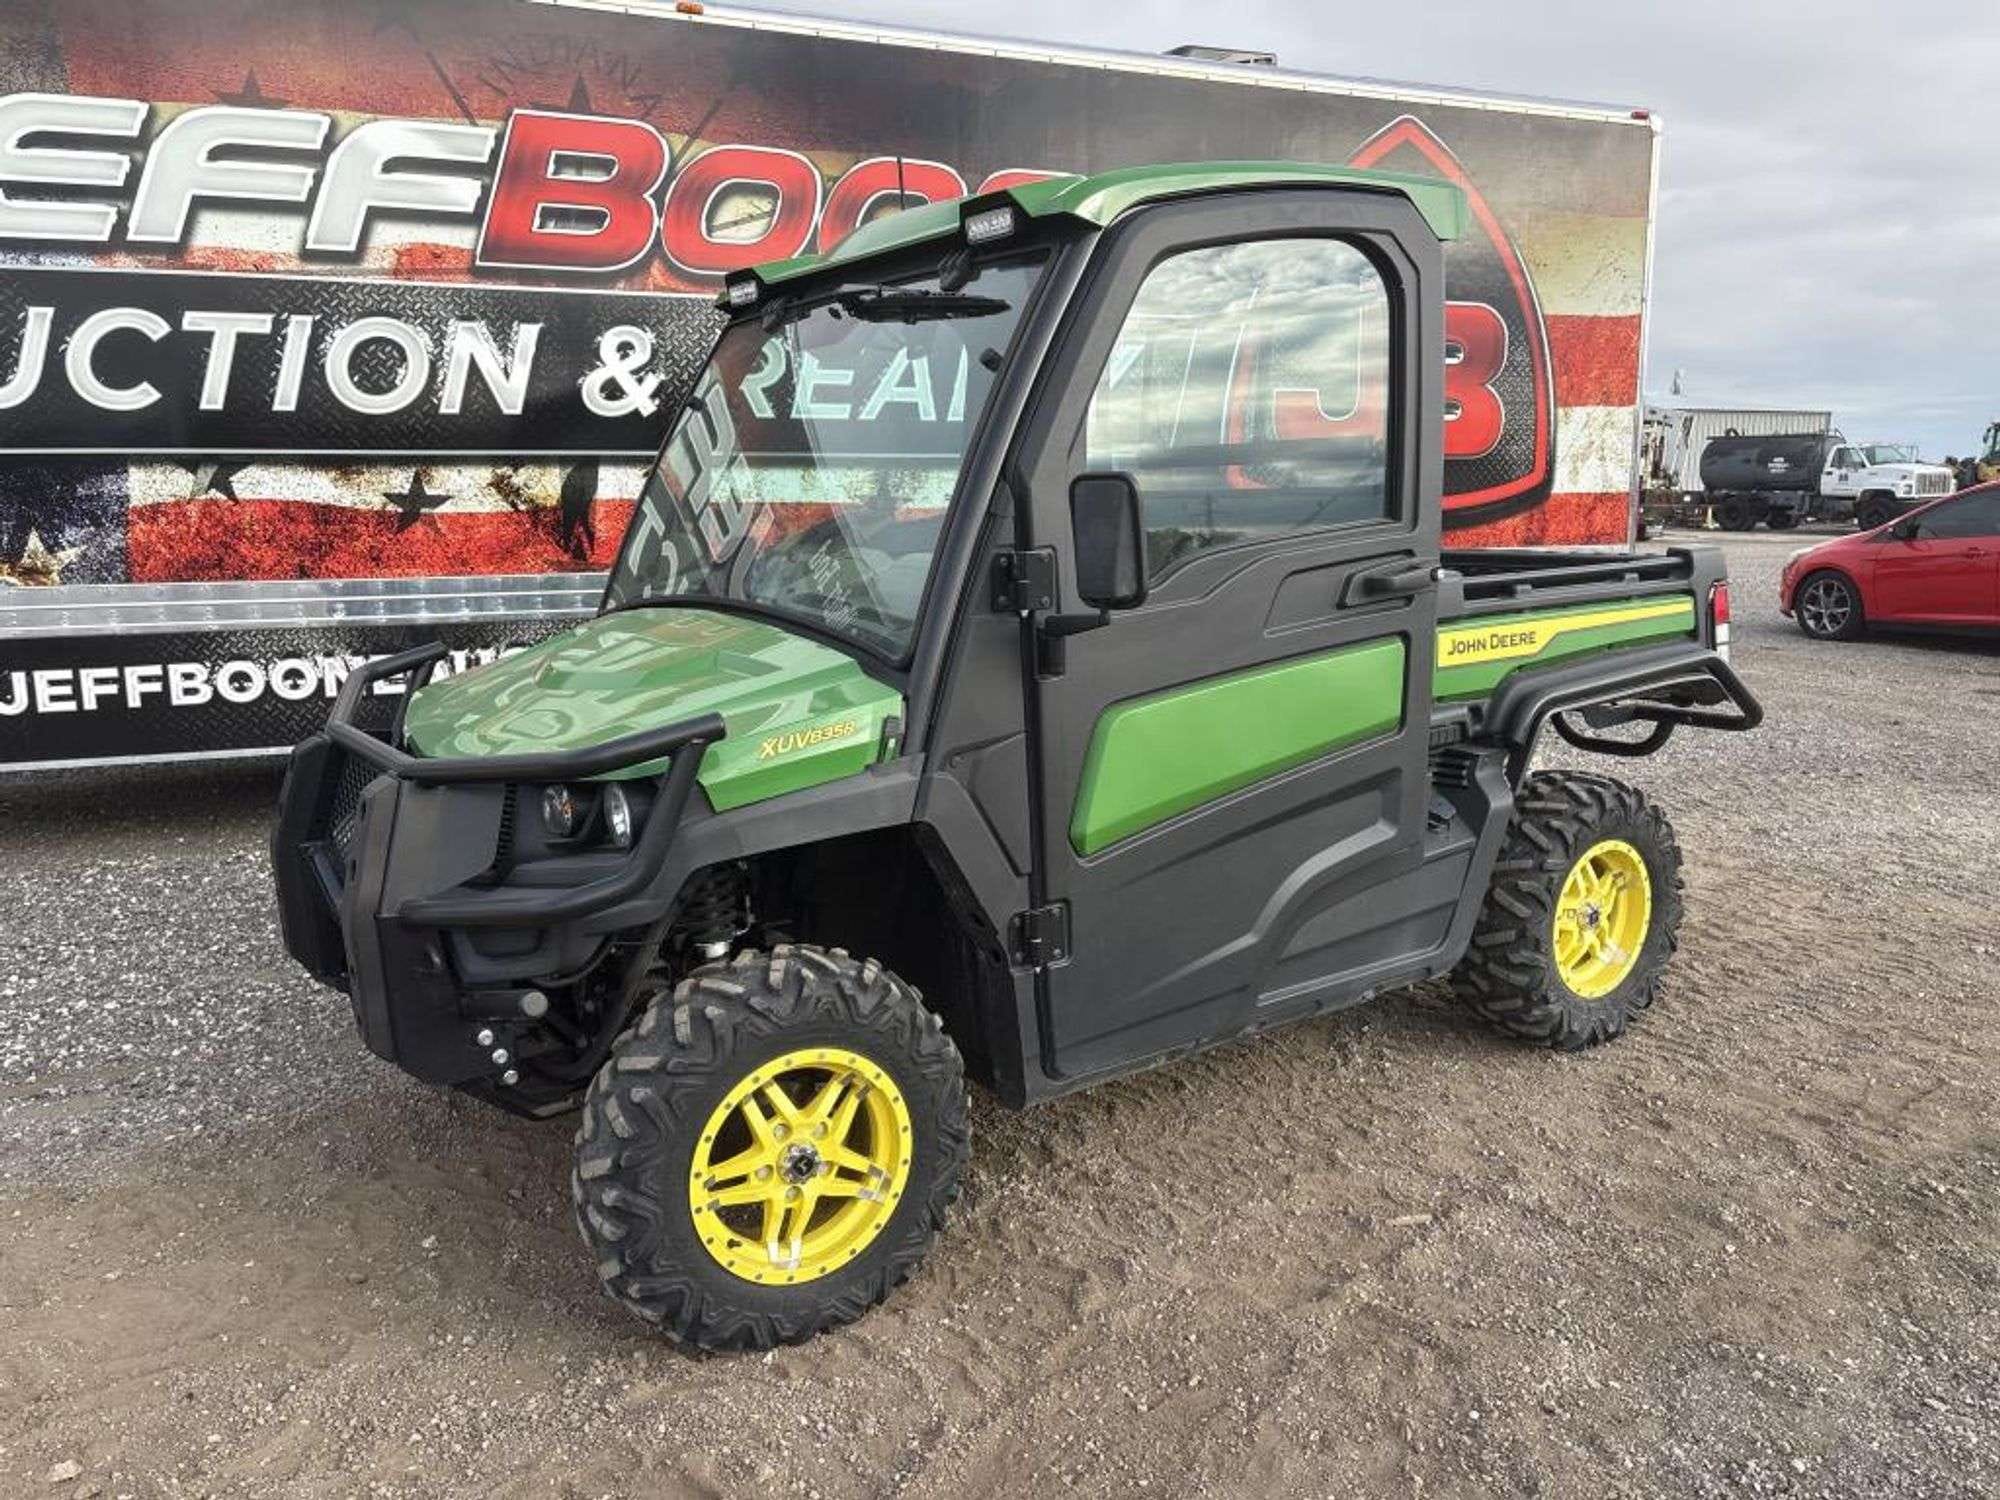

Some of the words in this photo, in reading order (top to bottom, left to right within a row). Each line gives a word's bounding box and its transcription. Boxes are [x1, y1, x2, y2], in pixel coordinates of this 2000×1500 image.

[582, 325, 664, 416] &
[1448, 638, 1487, 655] JOHN
[1490, 631, 1537, 650] DEERE
